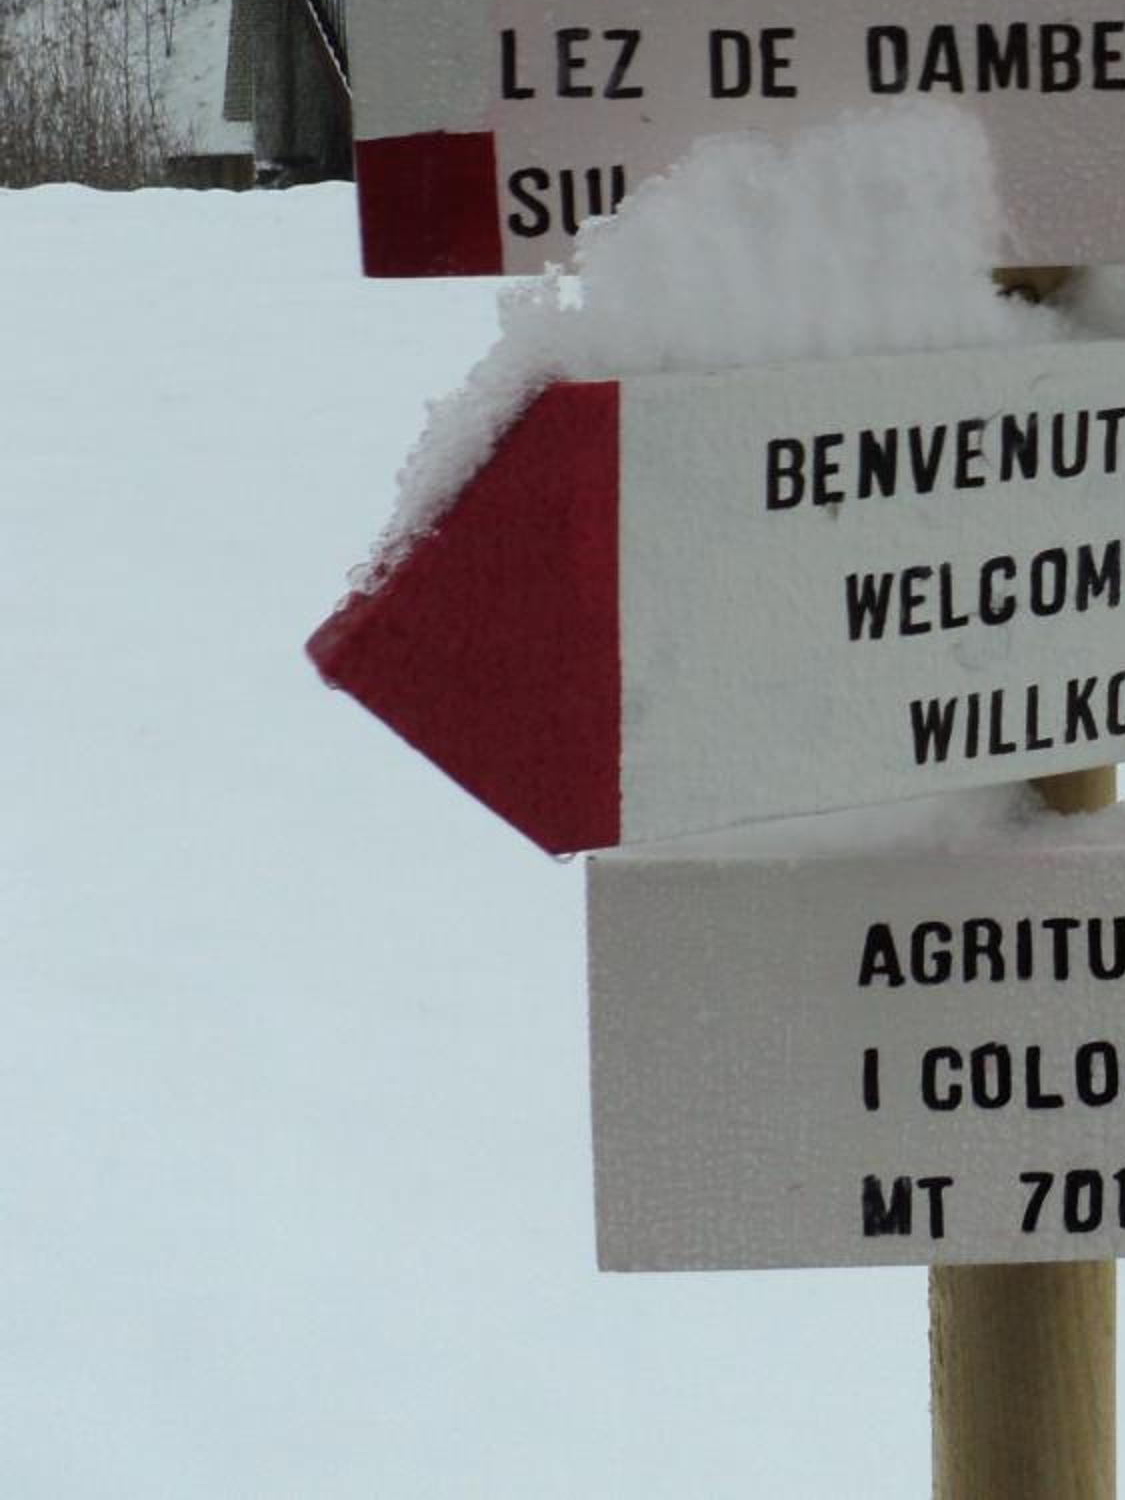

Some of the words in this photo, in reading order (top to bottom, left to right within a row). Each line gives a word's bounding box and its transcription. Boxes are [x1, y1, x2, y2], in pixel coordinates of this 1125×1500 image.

[500, 27, 644, 101] LEZ
[709, 27, 798, 99] DE
[862, 1047, 880, 1111] I
[861, 1173, 955, 1240] MT
